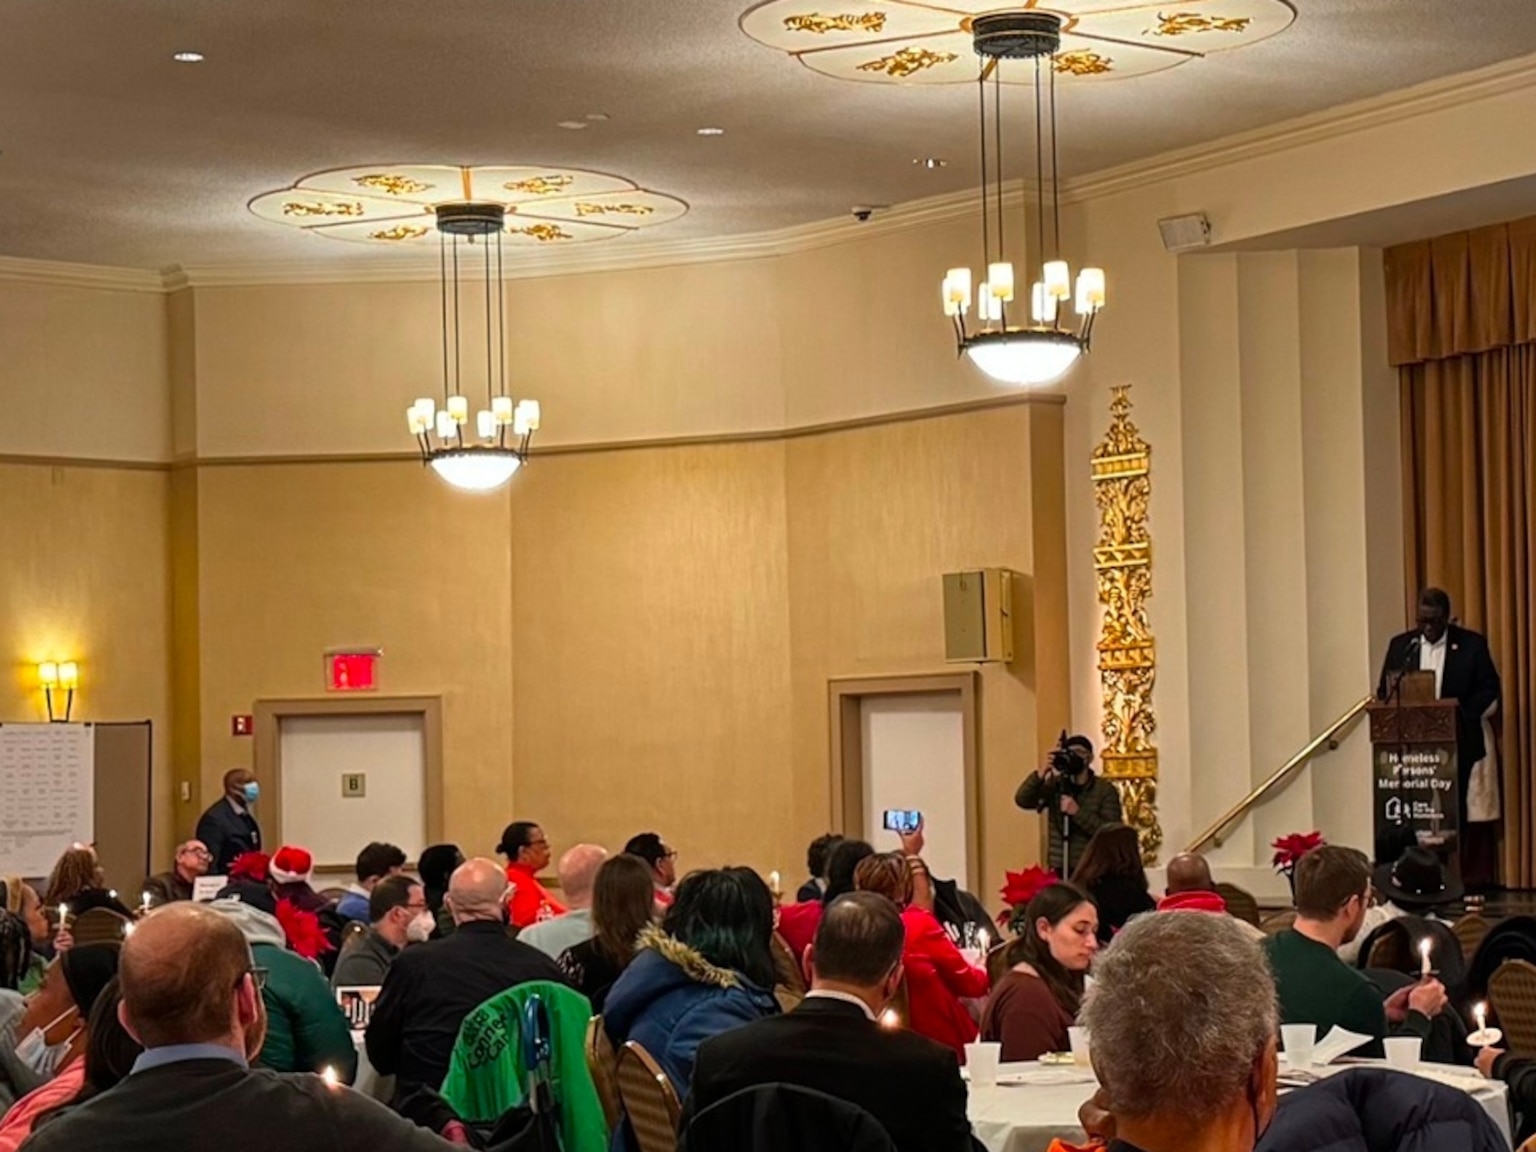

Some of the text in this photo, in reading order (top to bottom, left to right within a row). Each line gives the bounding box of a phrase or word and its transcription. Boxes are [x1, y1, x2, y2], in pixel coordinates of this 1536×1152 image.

[1388, 752, 1440, 763] Hmeless
[1392, 763, 1437, 776] Prsons'
[1430, 778, 1453, 791] Day
